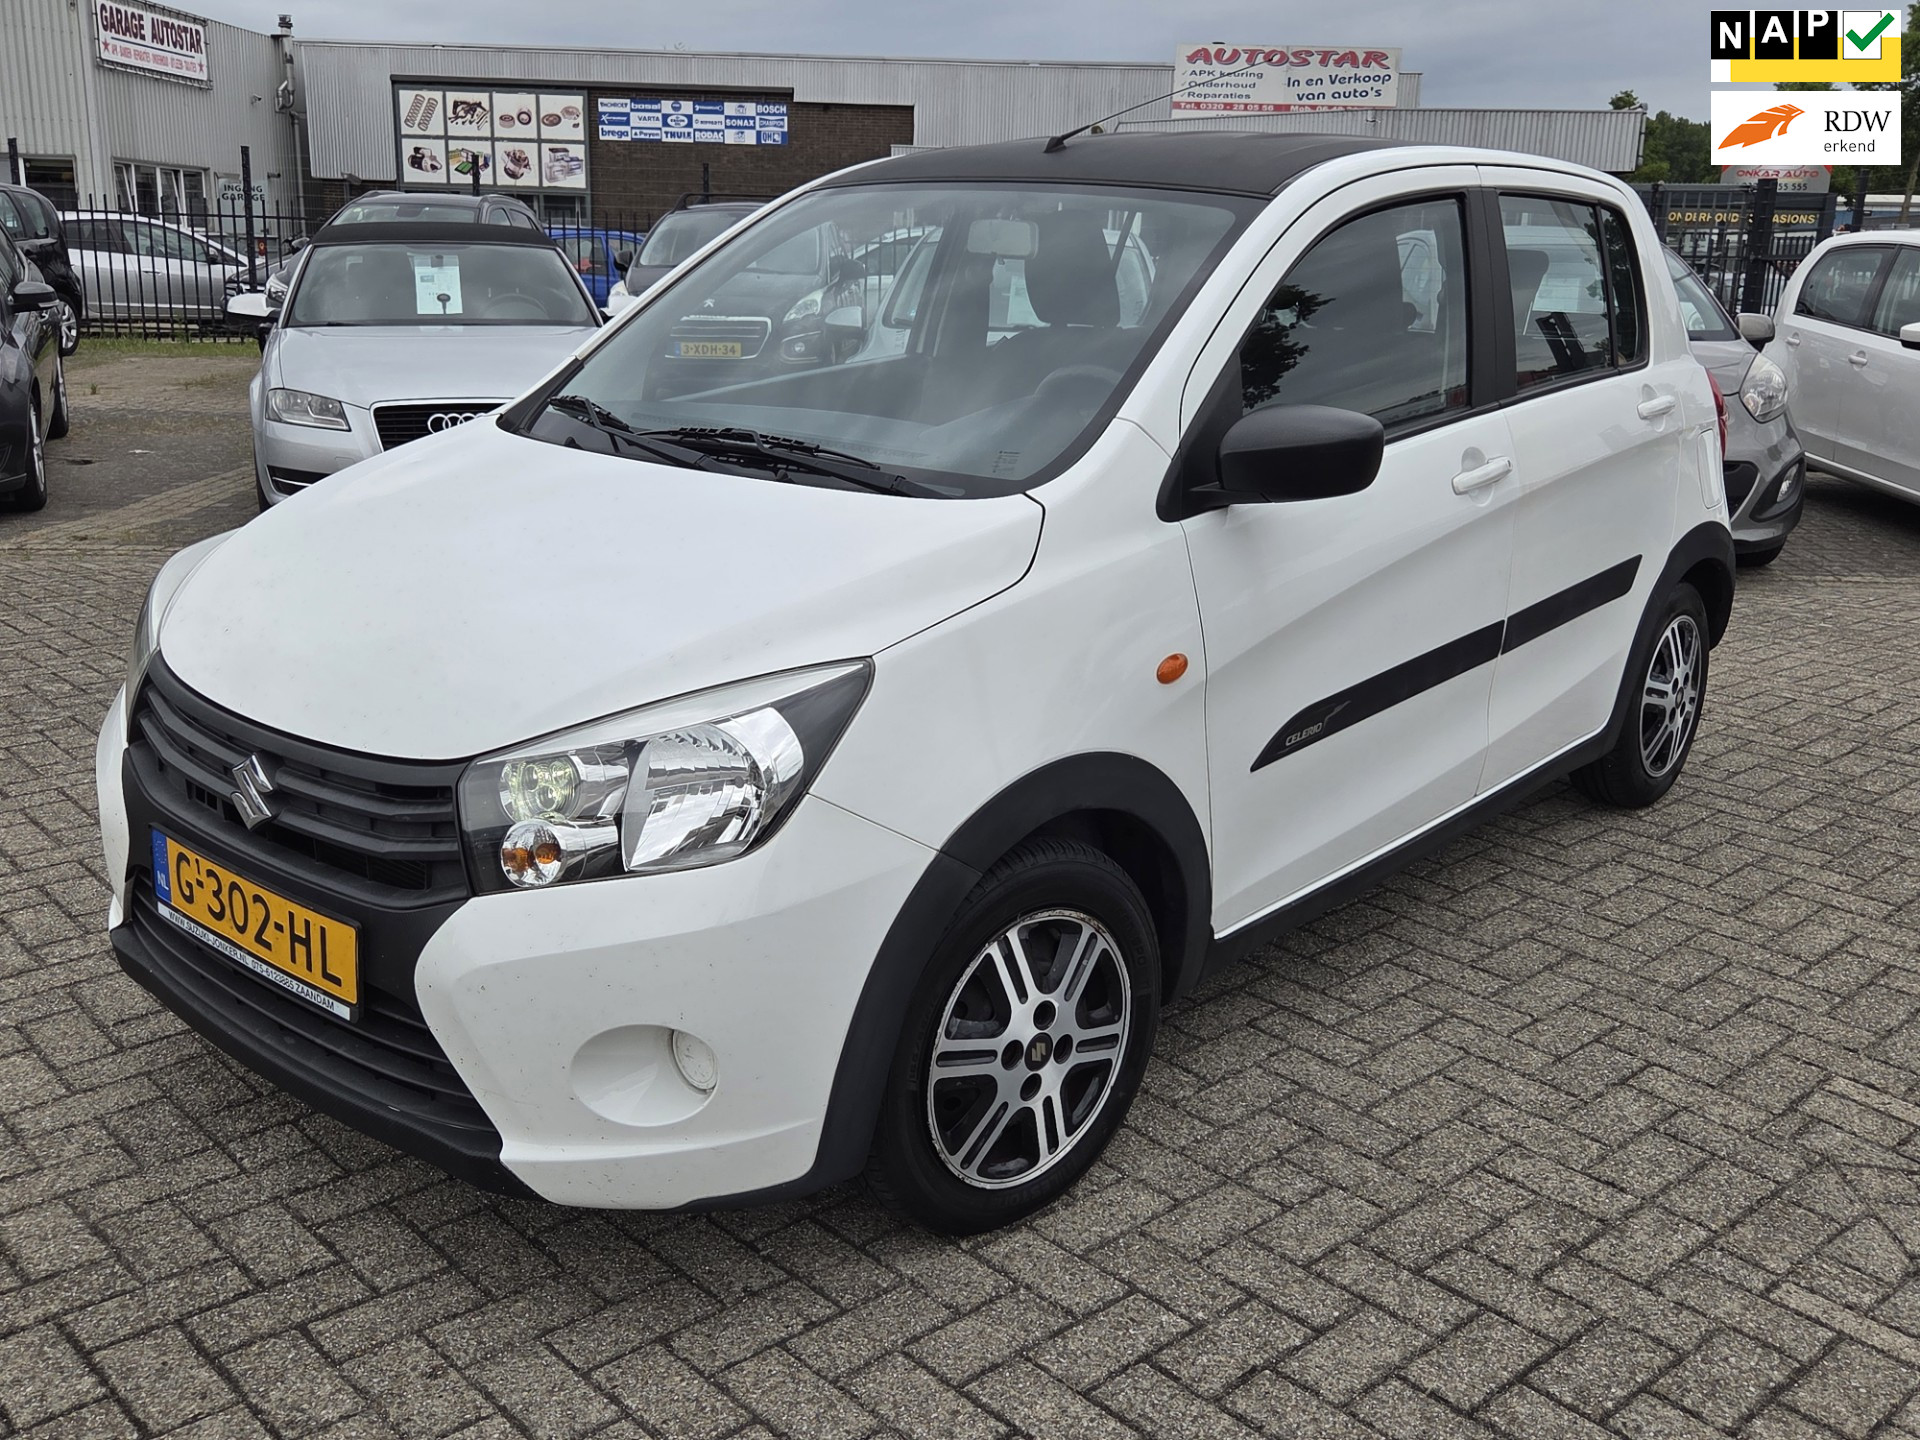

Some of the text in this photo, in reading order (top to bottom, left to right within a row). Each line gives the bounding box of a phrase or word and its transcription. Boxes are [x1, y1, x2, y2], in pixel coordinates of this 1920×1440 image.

[100, 3, 204, 55] GARAGE AUTOSTAR
[1186, 47, 1391, 70] AUTOSTAR
[1189, 69, 1264, 80] APK keuring
[1188, 80, 1257, 89] Onderhoud
[1287, 73, 1392, 88] In en Verkoop
[1187, 91, 1251, 100] Reparaties
[1296, 86, 1382, 102] van auto's
[757, 104, 787, 115] BOSCH
[1180, 102, 1198, 110] Tel.
[725, 118, 755, 127] SONAX
[600, 127, 629, 139] brega
[663, 131, 692, 140] THULE
[1736, 169, 1820, 178] ONKAR AUTO
[223, 184, 263, 193] INGNG
[1791, 183, 1808, 191] 555
[221, 193, 266, 201] GARGE
[1285, 722, 1323, 747] CELERIO
[157, 851, 343, 988] NL G-302-HL
[295, 985, 335, 1012] ZAANDAM
